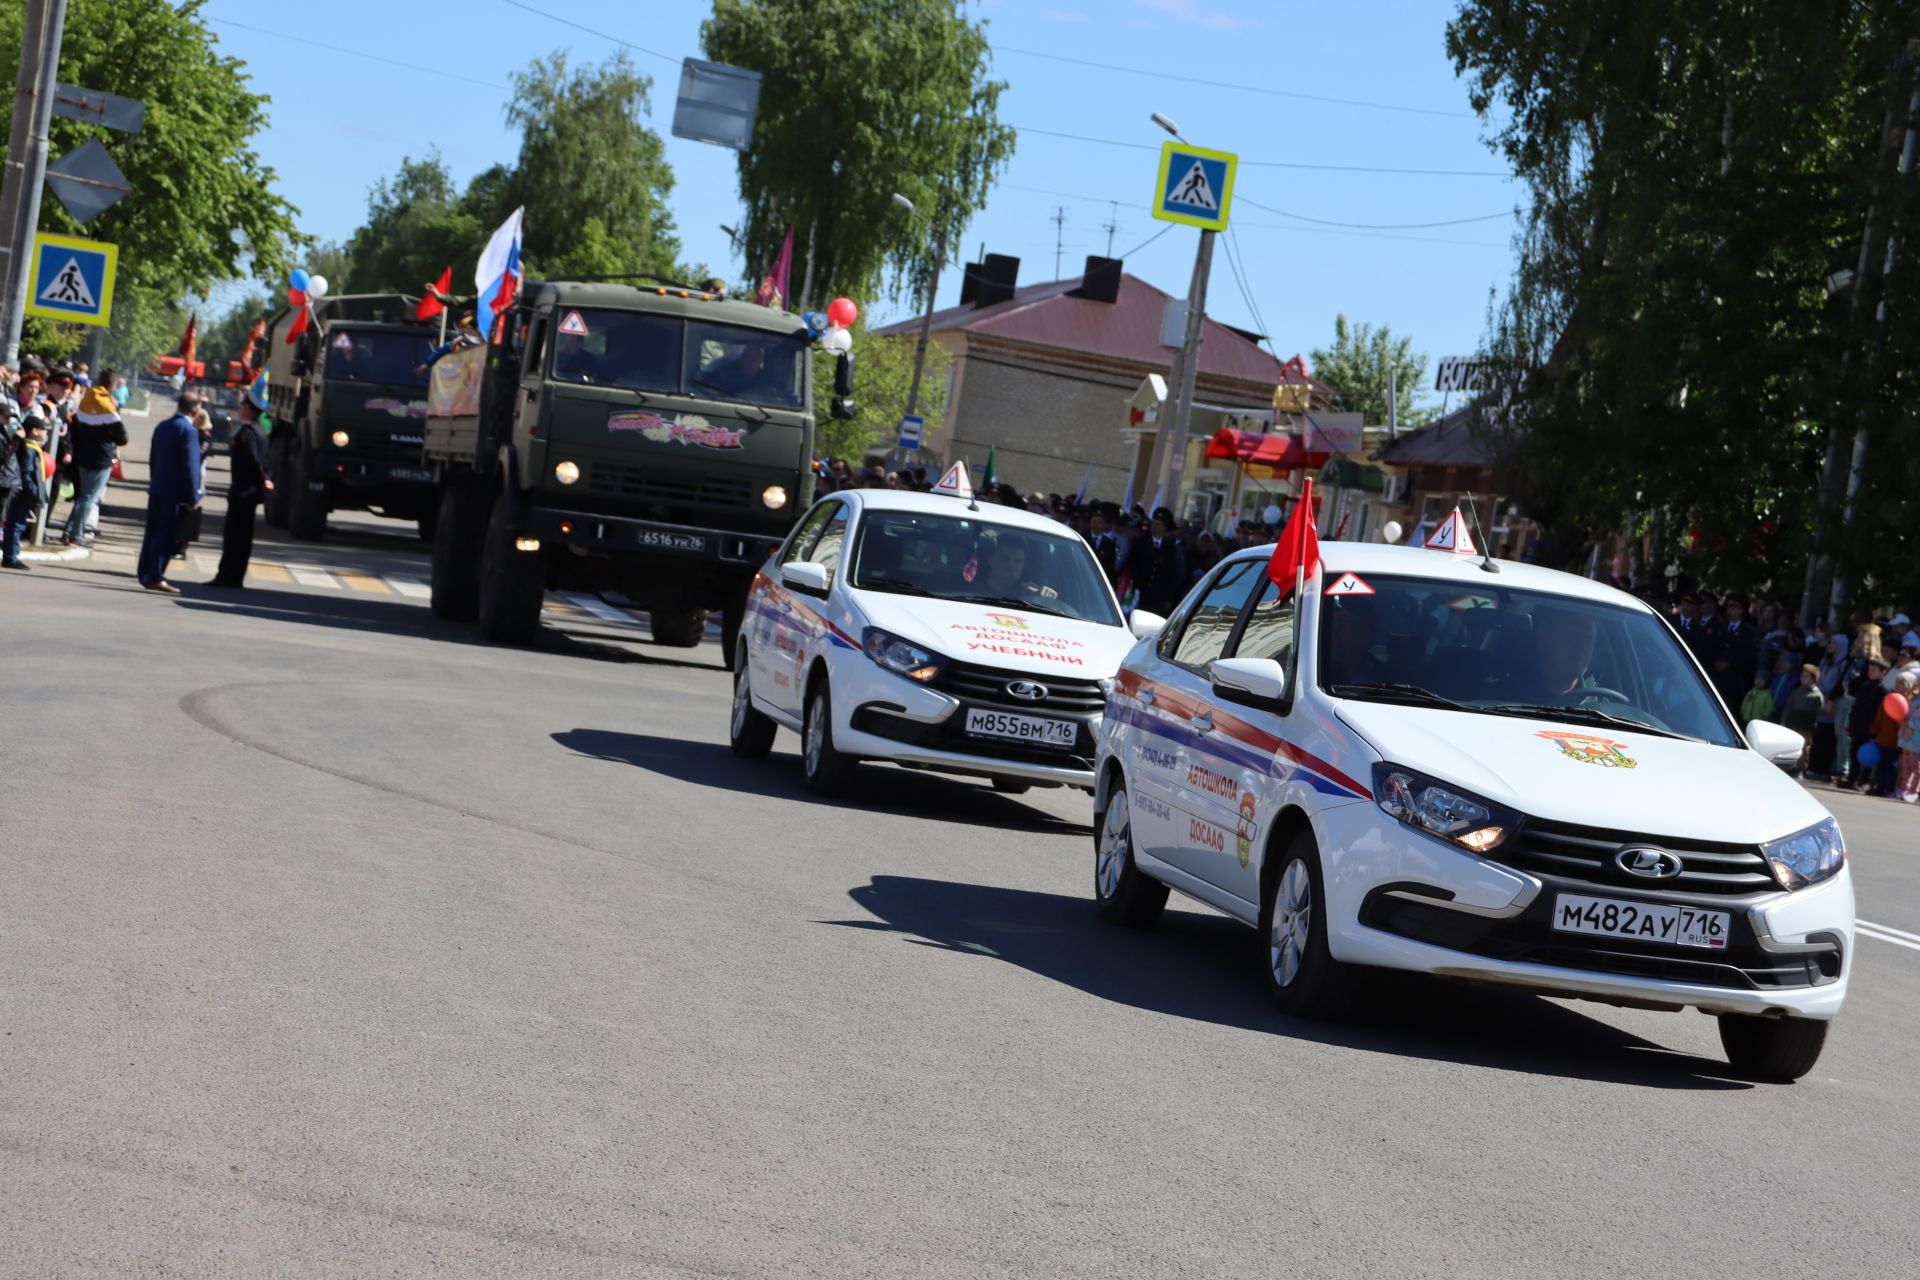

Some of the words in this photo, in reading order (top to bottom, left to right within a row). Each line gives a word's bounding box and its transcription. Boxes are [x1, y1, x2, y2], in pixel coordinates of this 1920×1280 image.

[1438, 525, 1453, 545] У
[1343, 580, 1356, 592] У
[951, 623, 1087, 648] АВТОШКОЛА
[975, 632, 1067, 650] ДОСААФ
[966, 641, 1084, 666] УЧЕБНЫЙ
[971, 713, 1044, 739] М855ВМ
[1046, 721, 1073, 738] 716
[1186, 763, 1239, 802] АВТОШКОЛА
[1189, 818, 1225, 853] ДОСААФ
[1562, 901, 1676, 938] М482АУ
[1682, 911, 1722, 936] 716
[1688, 933, 1709, 944] RUS
